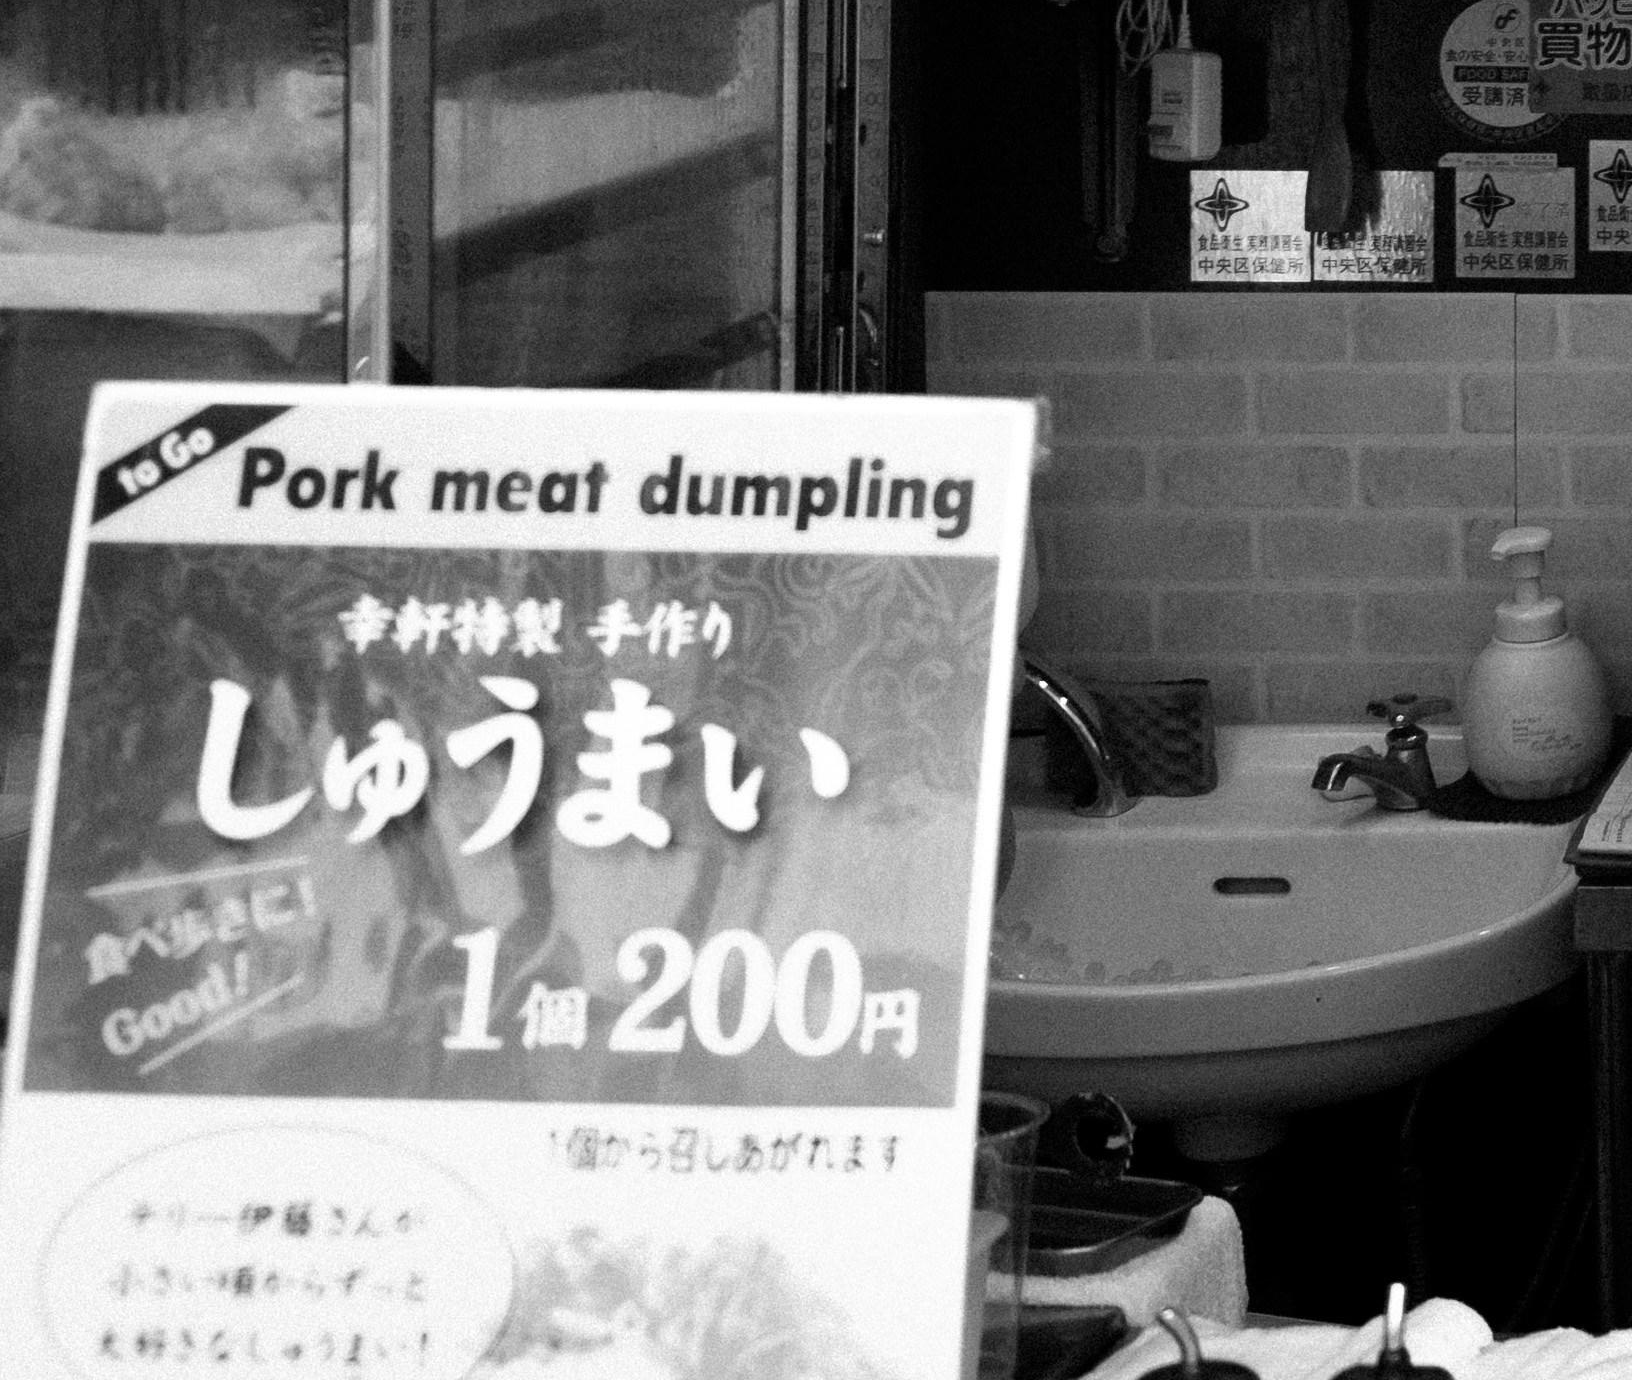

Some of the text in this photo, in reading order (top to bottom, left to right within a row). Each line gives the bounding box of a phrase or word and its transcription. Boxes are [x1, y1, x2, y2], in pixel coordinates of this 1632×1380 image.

[1198, 256, 1304, 275] 中央区保健所
[1321, 256, 1428, 275] 中央区保健所
[1463, 252, 1569, 272] 中央区保健所
[118, 424, 215, 497] to Go
[236, 446, 975, 539] Pork meat dumpling
[338, 594, 733, 658] 幸軒特製 手作り
[198, 676, 851, 856] しゅうまい
[101, 957, 250, 1057] Good!
